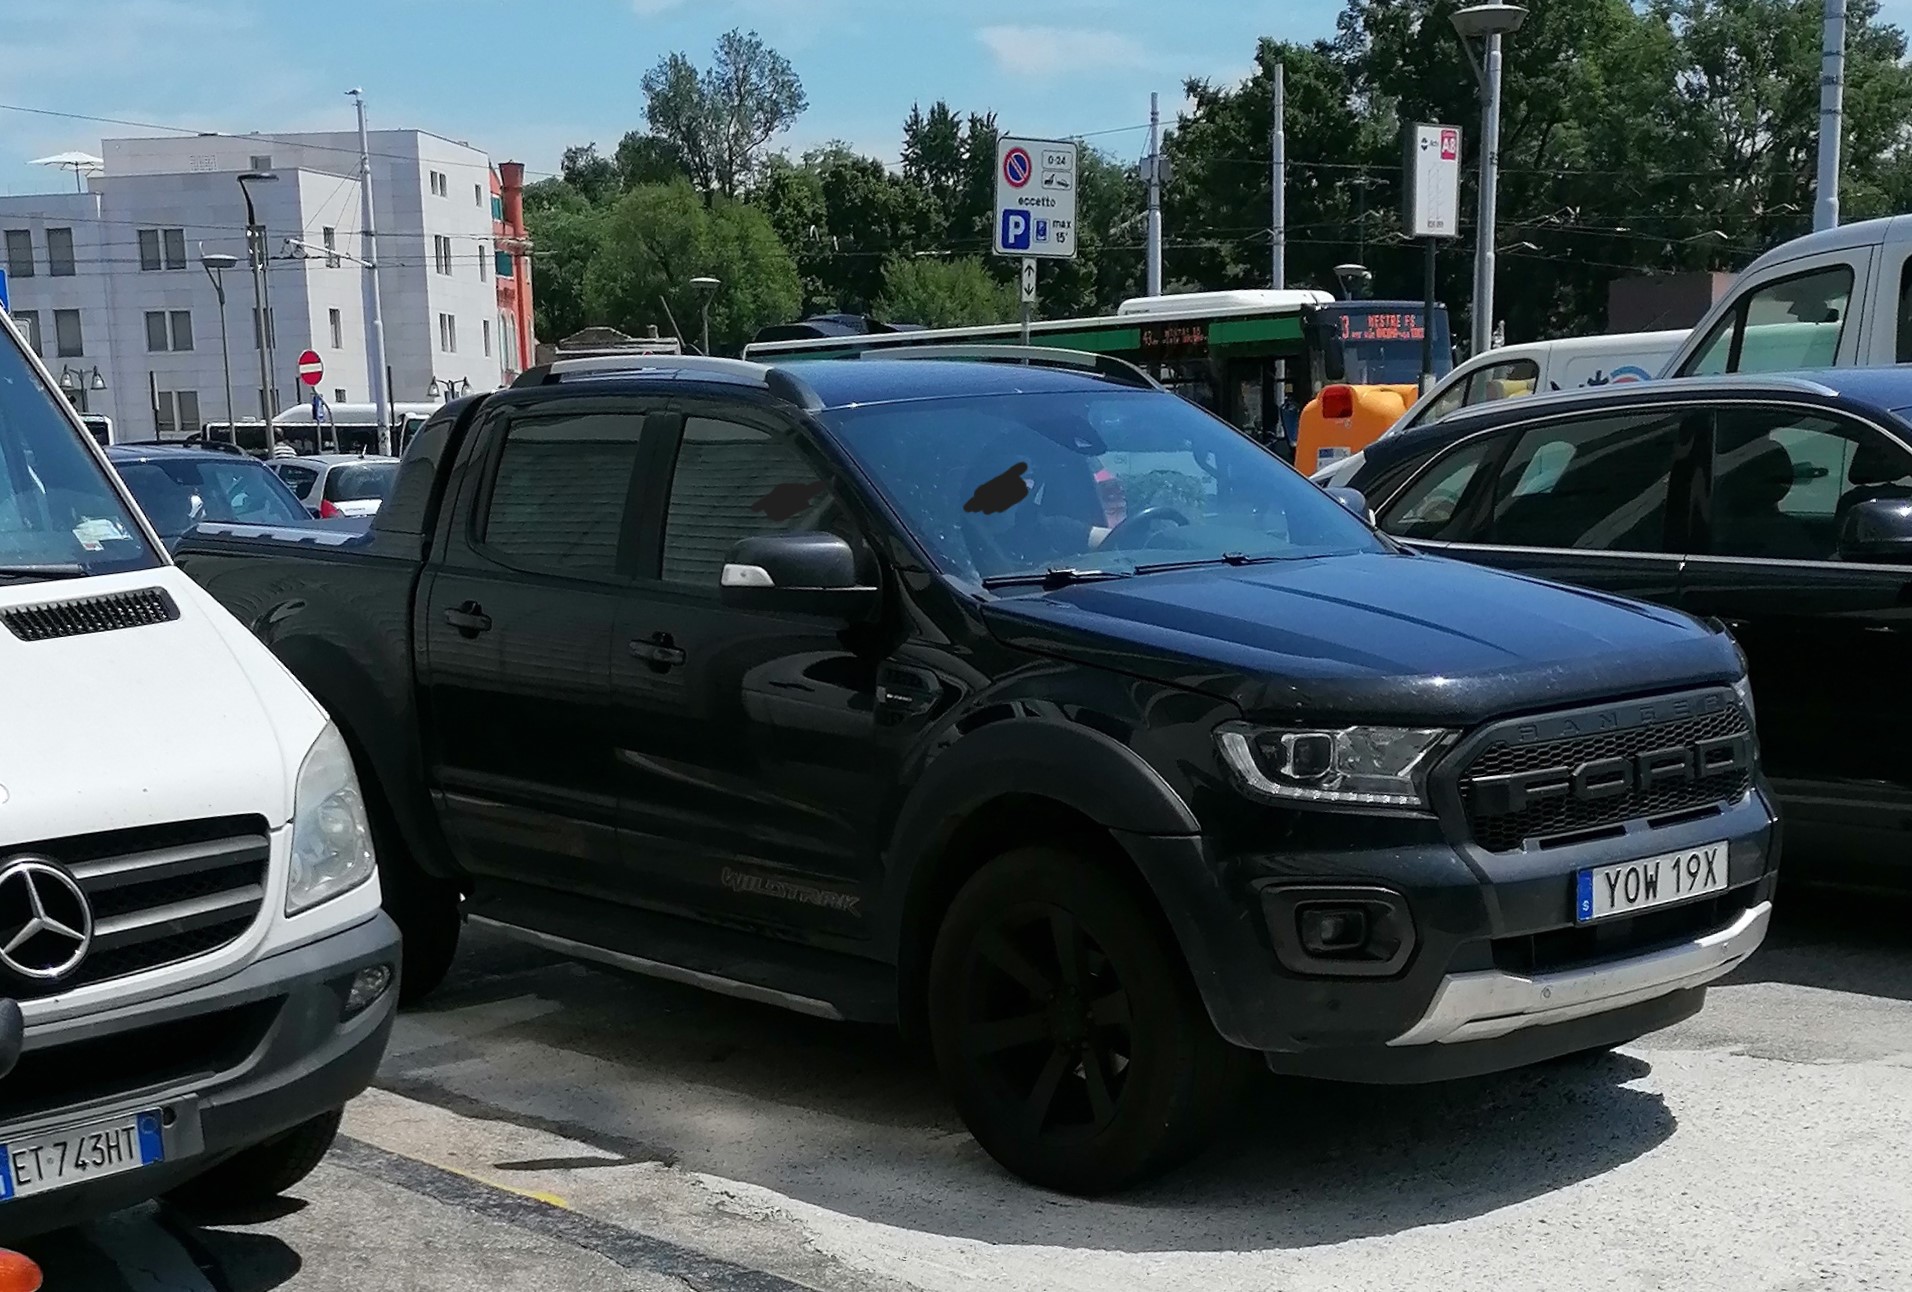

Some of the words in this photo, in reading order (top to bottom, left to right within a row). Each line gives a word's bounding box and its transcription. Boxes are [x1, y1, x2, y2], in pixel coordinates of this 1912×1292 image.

[1018, 196, 1056, 207] eccetto
[1009, 215, 1025, 243] P
[1052, 220, 1071, 228] max
[1518, 693, 1720, 742] RANGER
[1471, 734, 1750, 815] FORD
[1605, 861, 1660, 908] YOW
[1672, 848, 1718, 893] 19X
[1582, 900, 1590, 911] S
[12, 1146, 44, 1186] ET
[53, 1126, 136, 1177] 743HT
